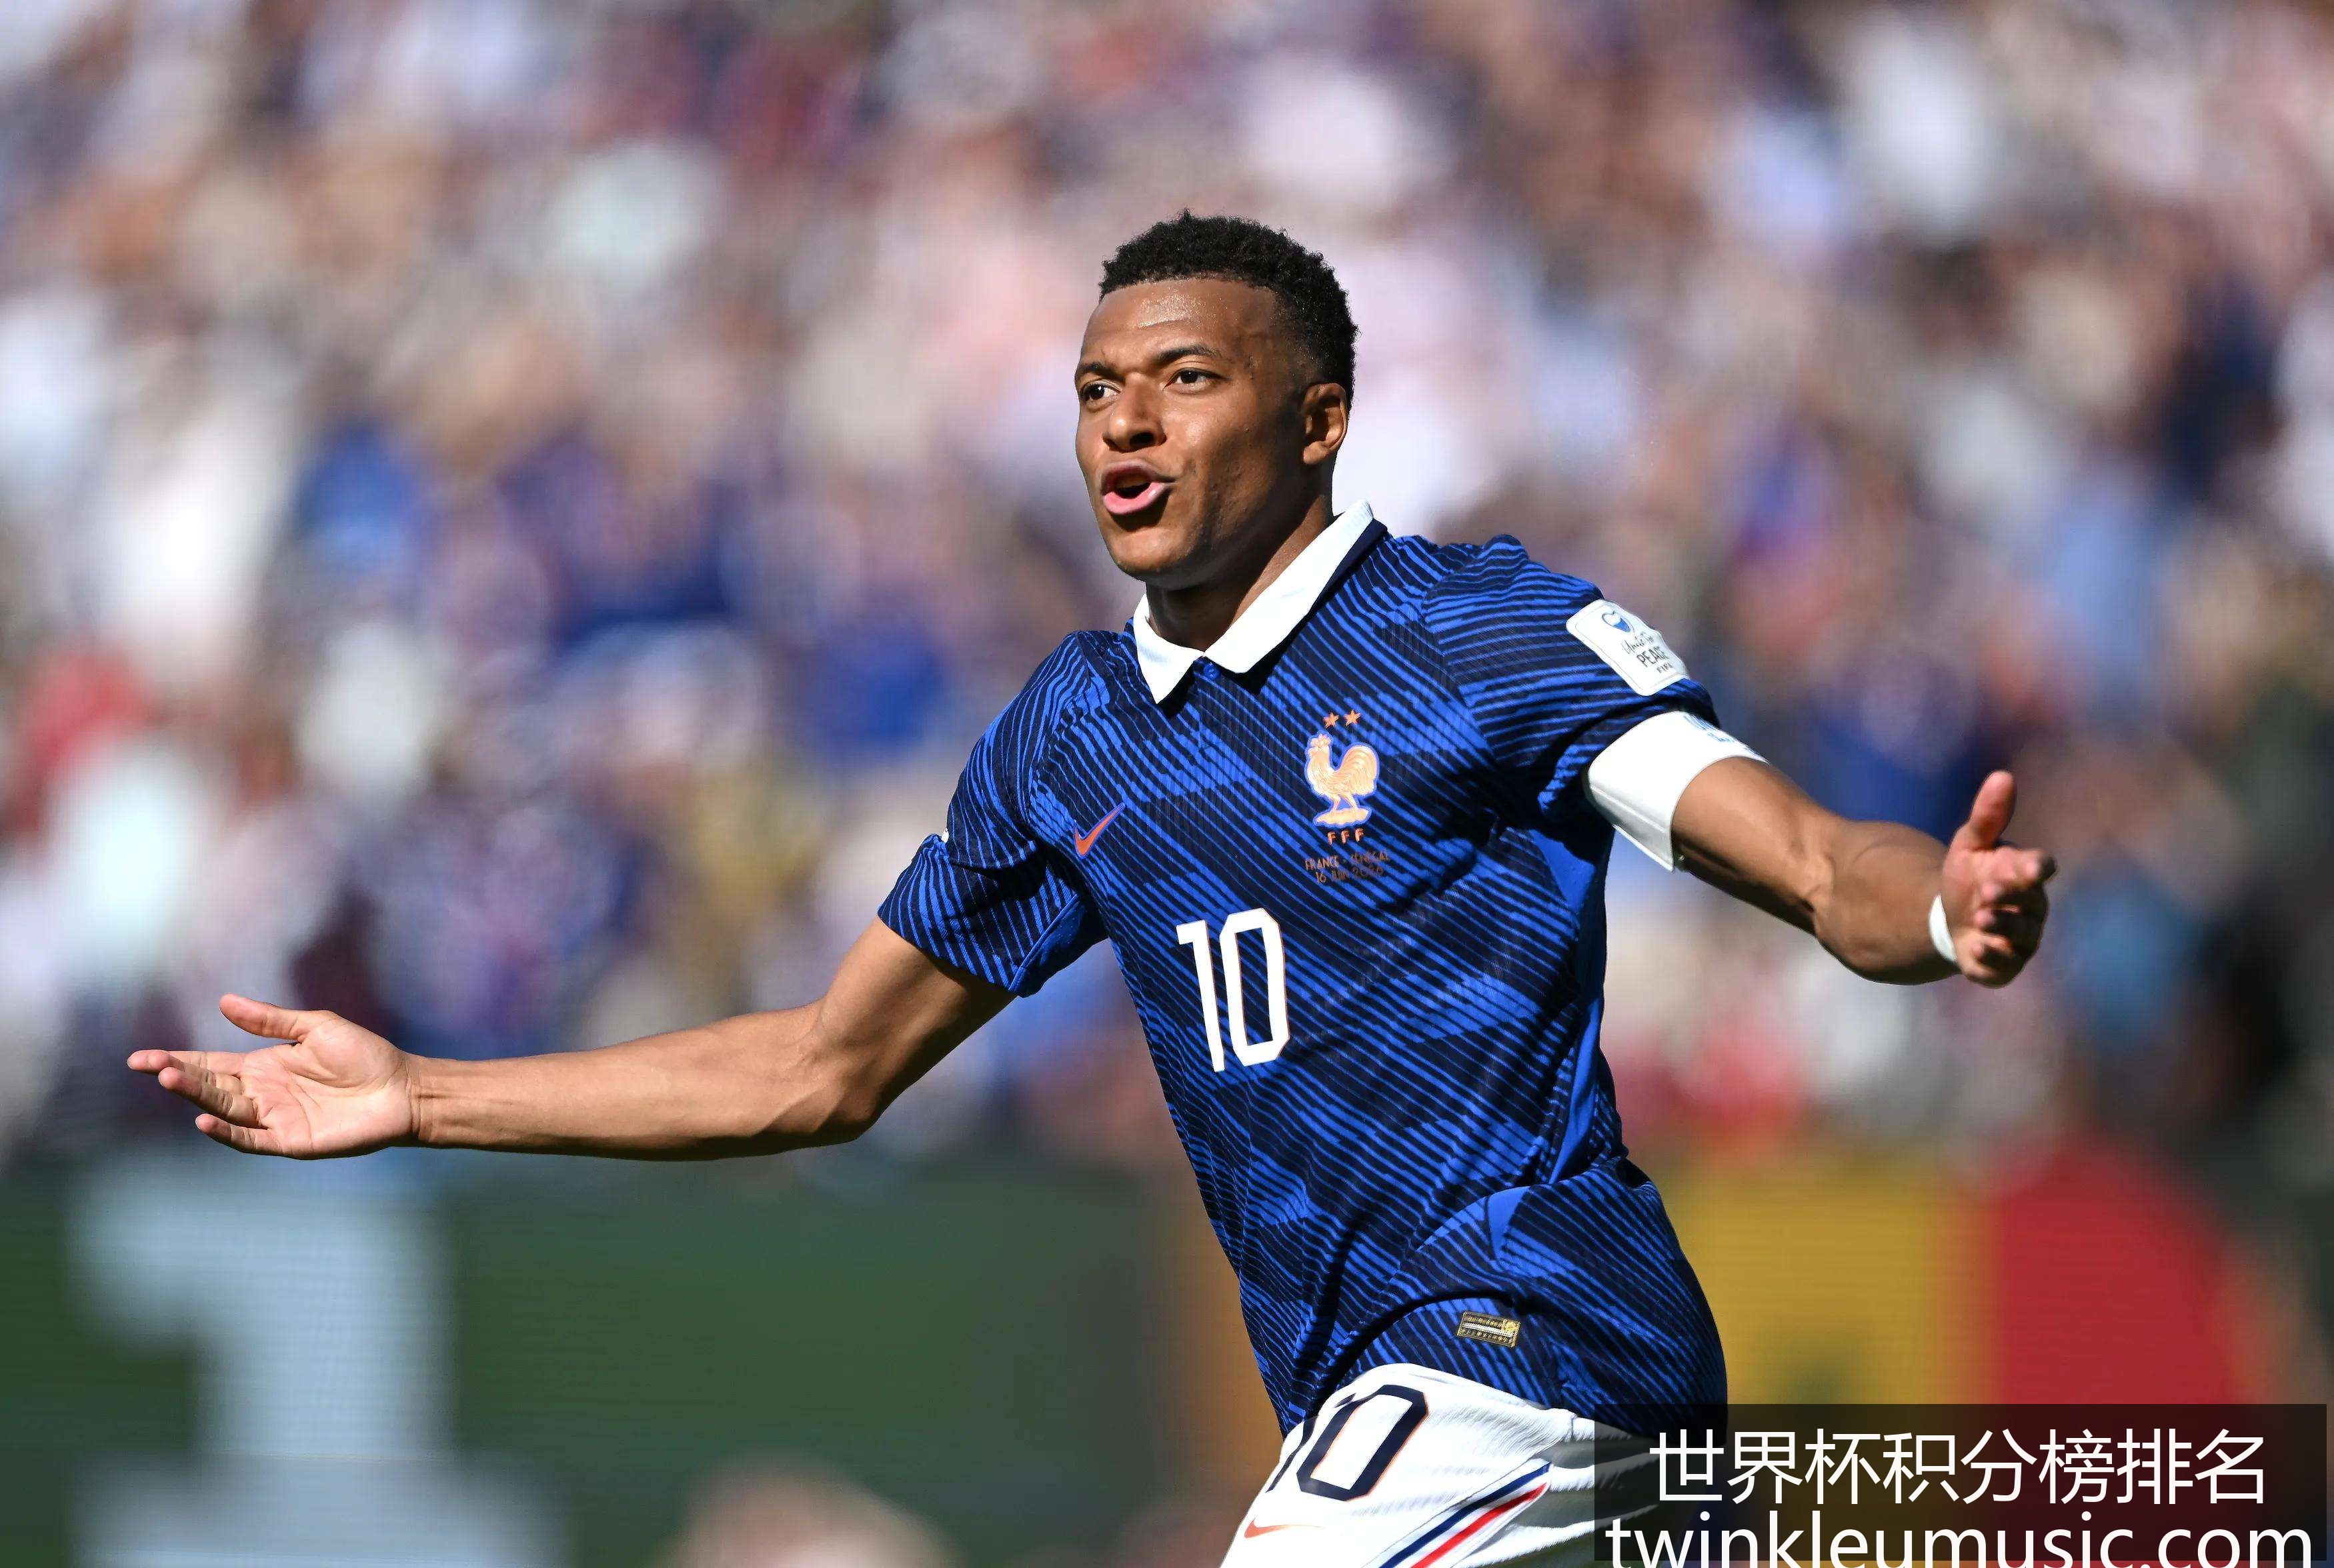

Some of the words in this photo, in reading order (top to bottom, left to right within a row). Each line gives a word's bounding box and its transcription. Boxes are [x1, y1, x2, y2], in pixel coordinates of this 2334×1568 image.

[1636, 645, 1669, 667] PEACE
[1305, 855, 1339, 871] FRANCE
[1315, 871, 1327, 884] 16
[1176, 907, 1291, 1073] 10
